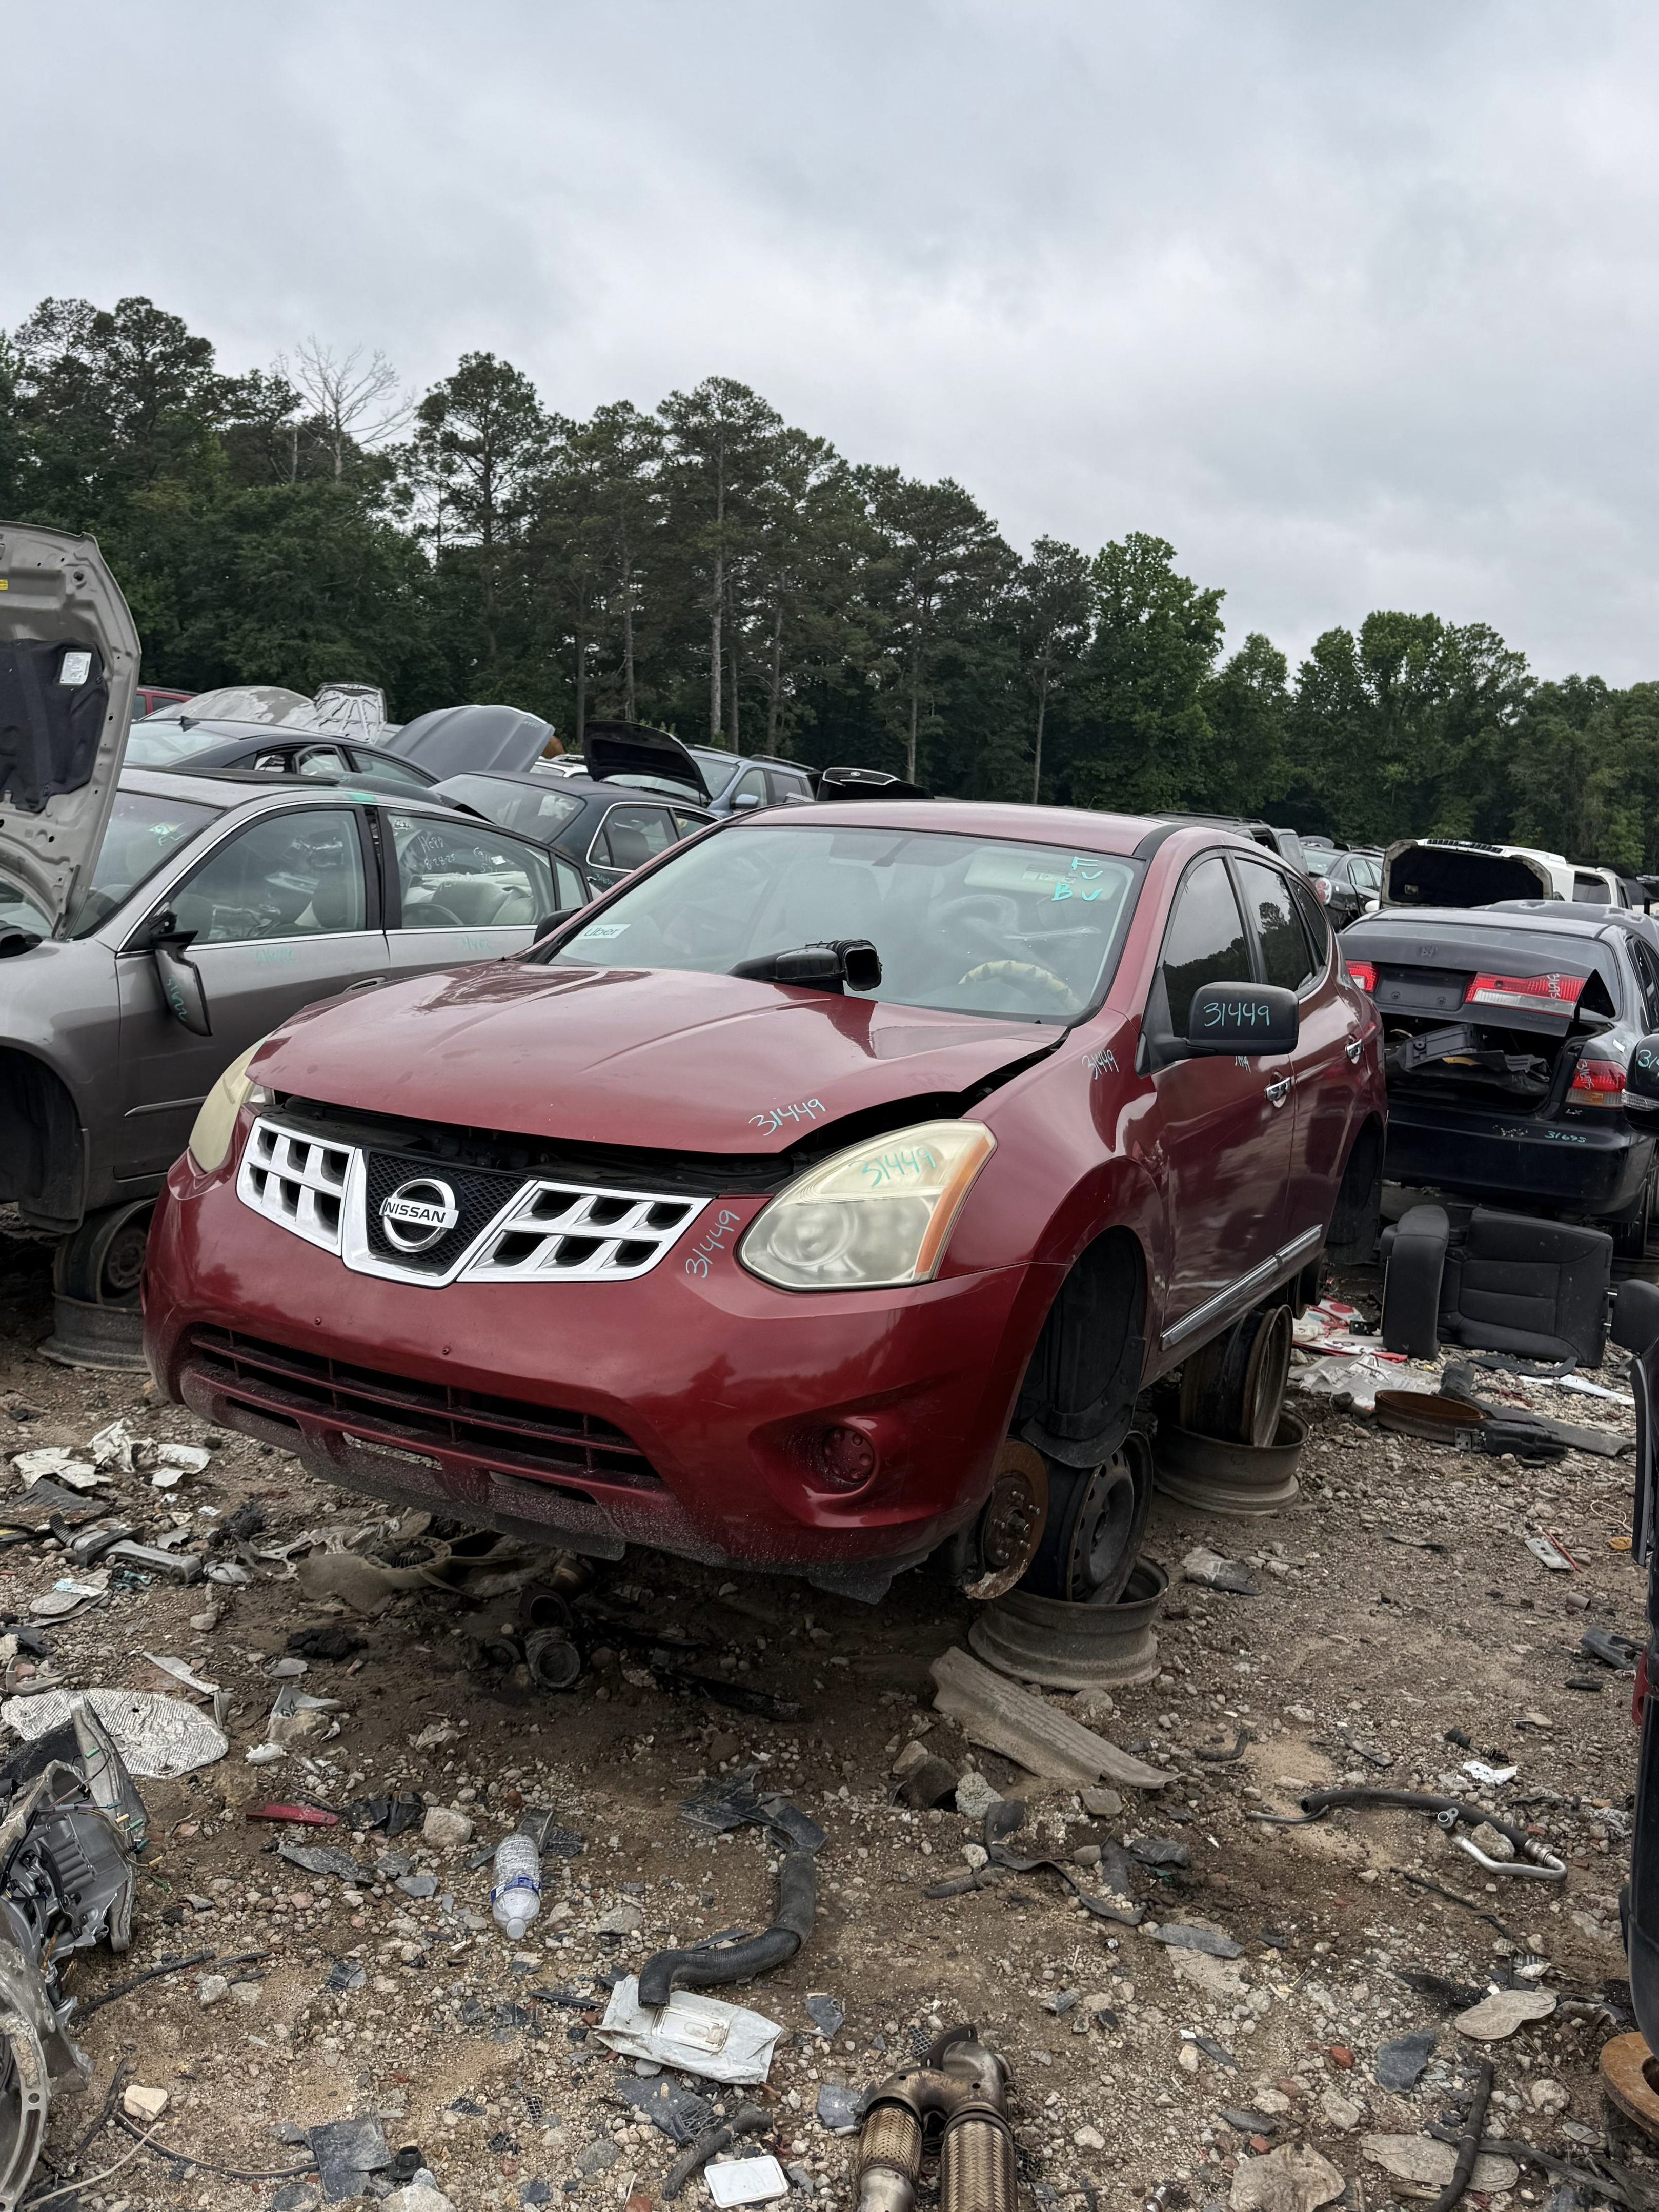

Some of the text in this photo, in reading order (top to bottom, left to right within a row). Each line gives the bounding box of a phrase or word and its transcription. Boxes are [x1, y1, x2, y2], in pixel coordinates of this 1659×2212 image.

[1051, 882, 1073, 901] B
[584, 927, 620, 937] Uber
[1203, 1002, 1270, 1027] 31449
[1082, 1049, 1119, 1080] 31449
[1638, 1049, 1659, 1077] 31
[748, 1099, 826, 1136] 31449
[848, 1147, 936, 1187] 31449
[385, 1202, 446, 1223] NISSAN
[685, 1210, 741, 1279] 31449
